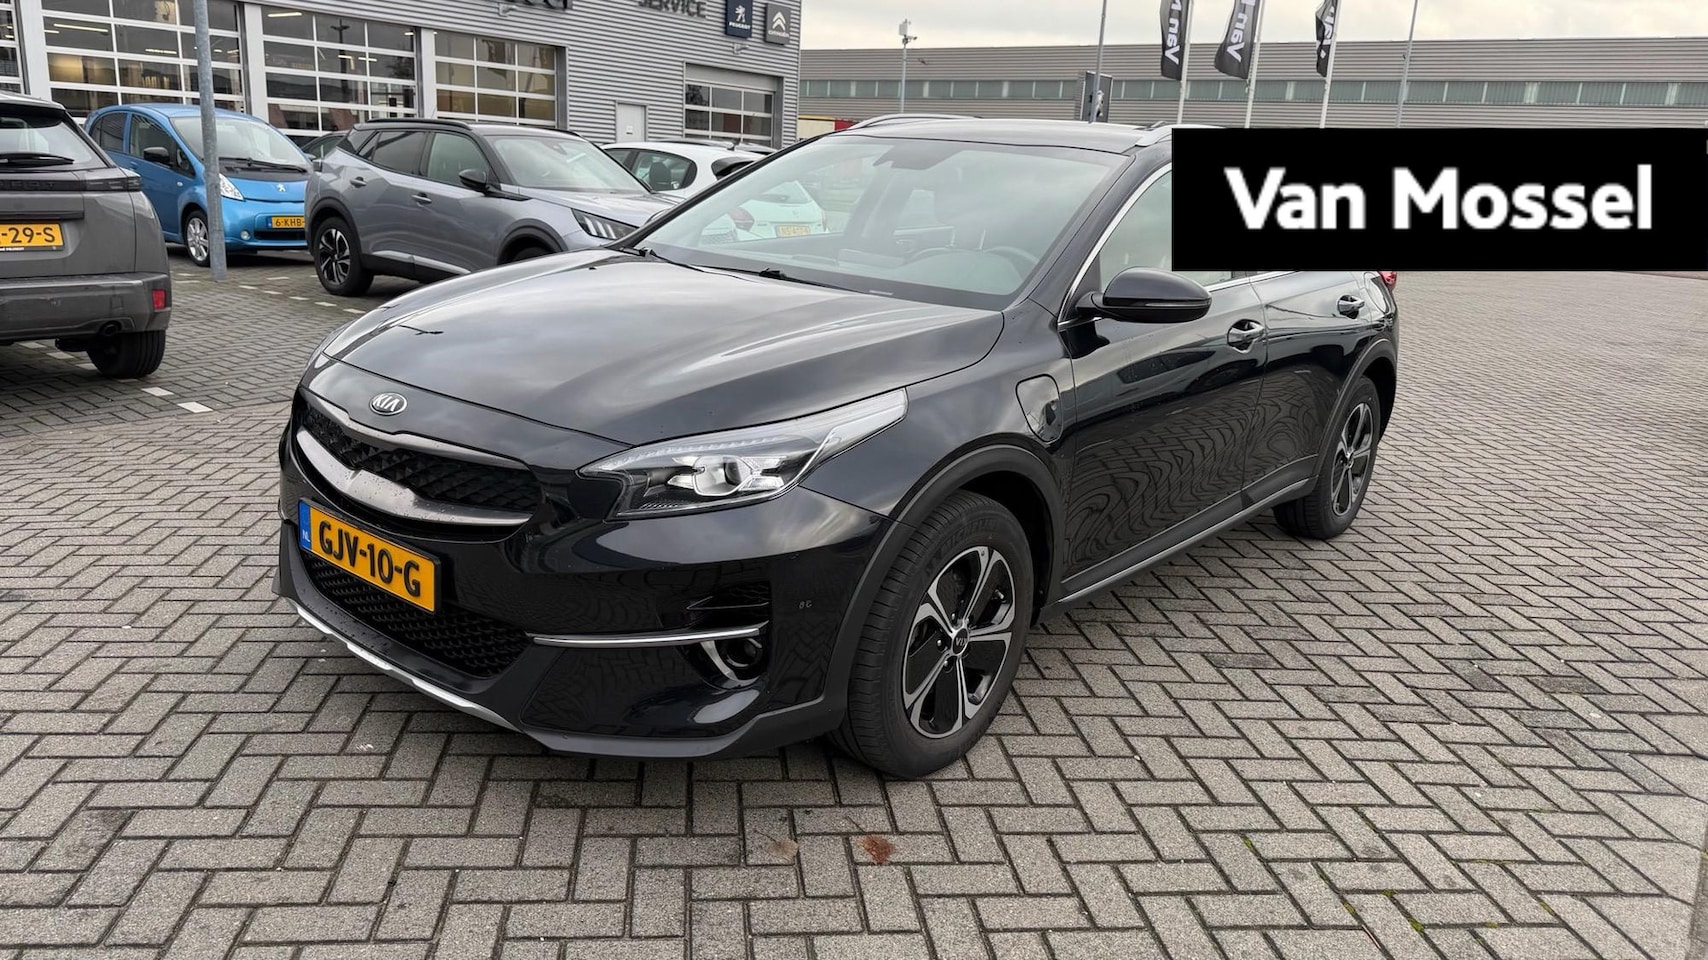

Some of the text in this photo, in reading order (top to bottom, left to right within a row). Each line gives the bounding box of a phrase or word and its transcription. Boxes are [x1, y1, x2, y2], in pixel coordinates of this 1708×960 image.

[0, 227, 55, 243] -29-S
[372, 394, 400, 412] KIA
[319, 520, 420, 598] GJV-10-G
